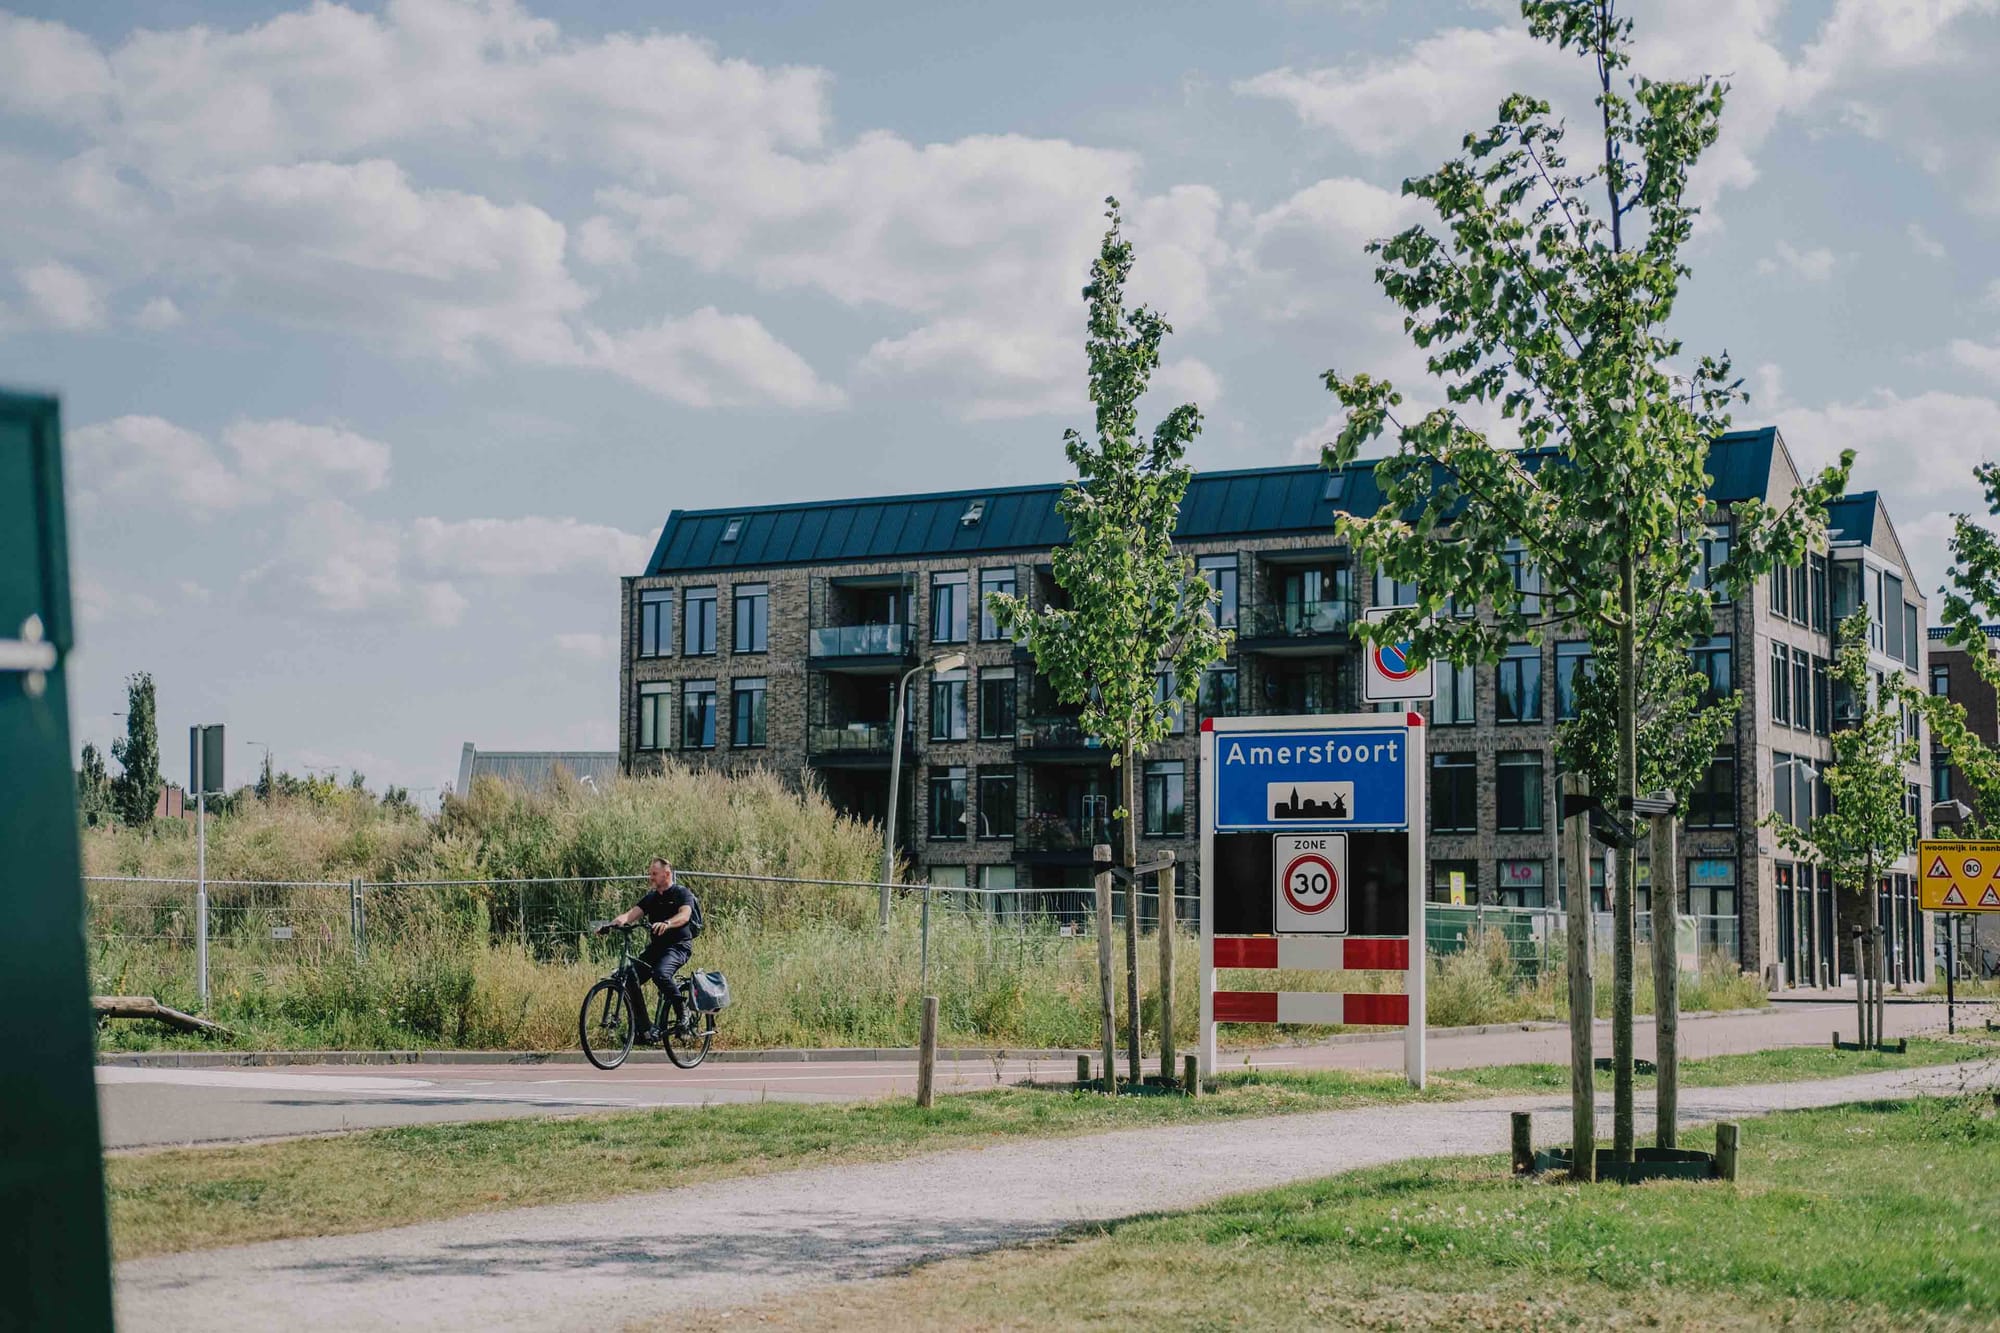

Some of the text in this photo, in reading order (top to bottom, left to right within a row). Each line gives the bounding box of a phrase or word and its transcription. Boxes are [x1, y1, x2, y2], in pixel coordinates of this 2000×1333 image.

[1226, 740, 1397, 765] Amersfoort
[1294, 840, 1327, 850] ZONE
[1293, 873, 1328, 895] 30
